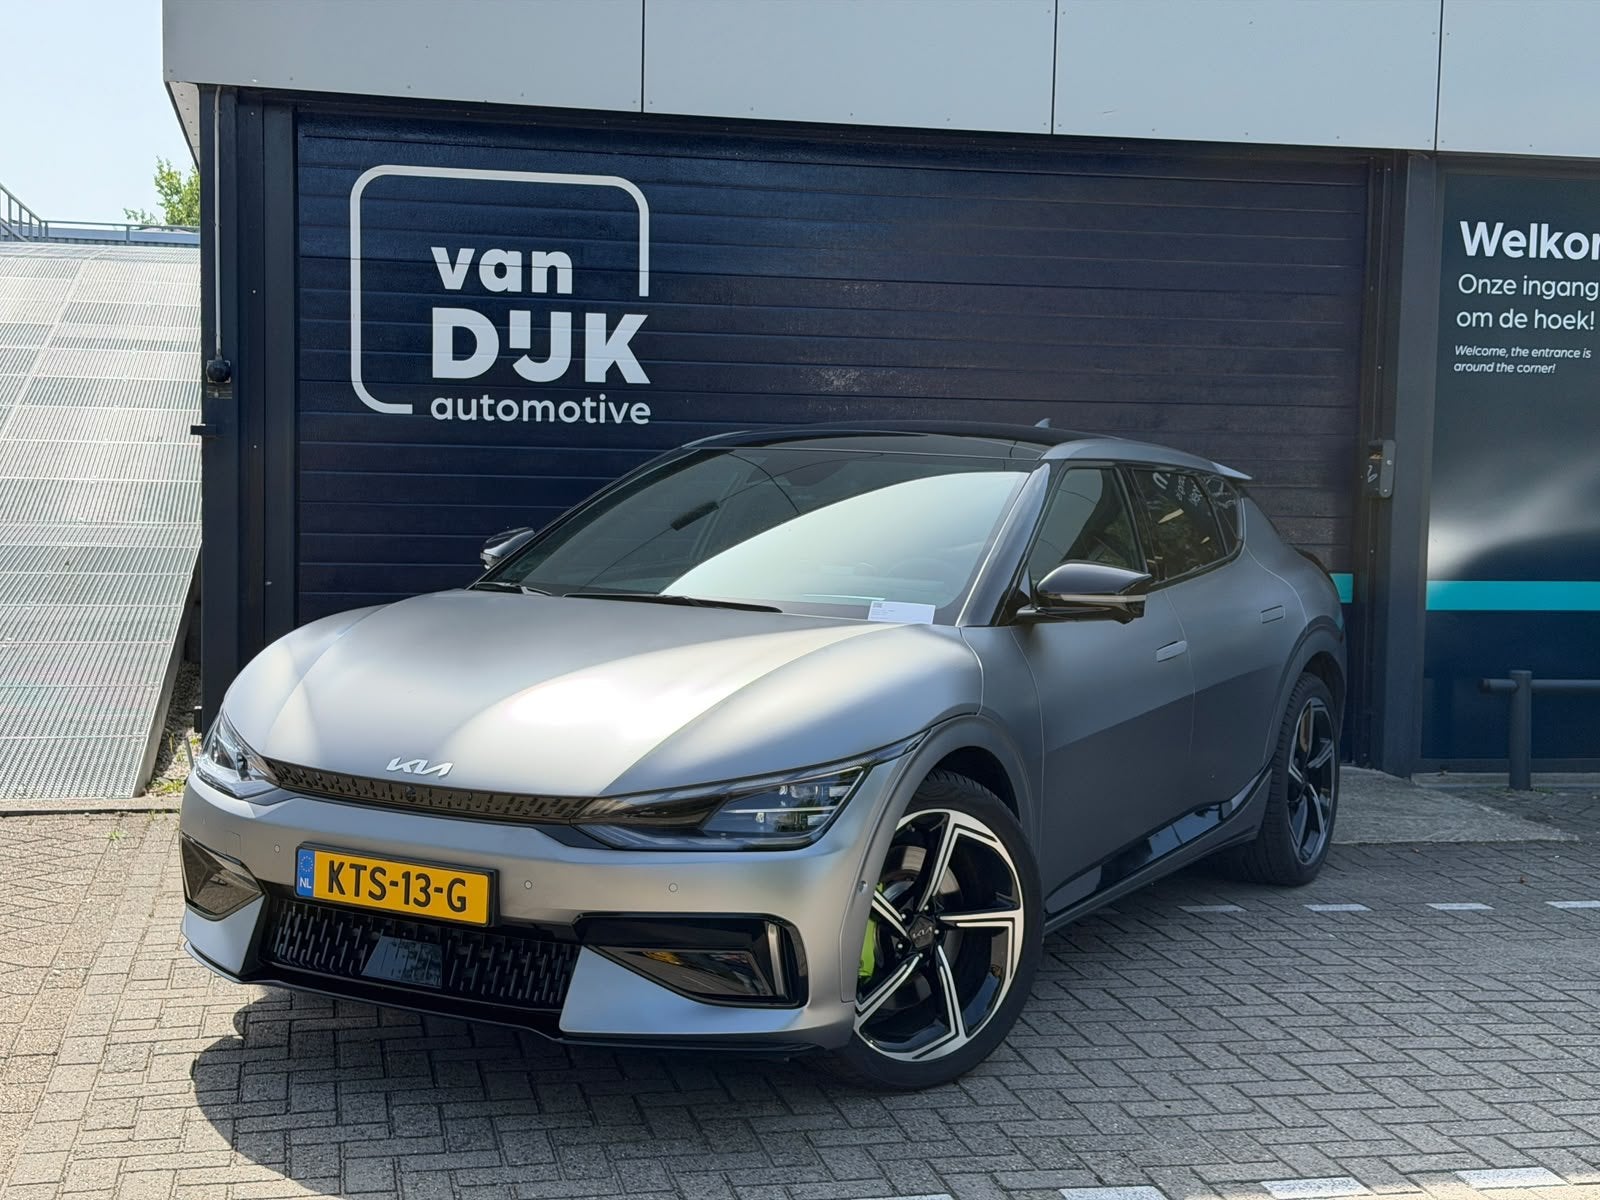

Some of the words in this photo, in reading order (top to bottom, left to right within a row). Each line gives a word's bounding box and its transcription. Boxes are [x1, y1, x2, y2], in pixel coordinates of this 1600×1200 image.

[1460, 221, 1600, 260] Welko
[431, 247, 573, 294] van
[1458, 273, 1517, 295] Onze
[1522, 275, 1599, 301] ingang
[1456, 311, 1493, 328] om
[1499, 308, 1528, 329] de
[1534, 309, 1595, 331] hoek!
[1455, 345, 1509, 358] Welcome,
[1510, 347, 1530, 357] the
[1531, 348, 1580, 359] entrance
[1582, 348, 1592, 359] is
[1453, 362, 1494, 373] around
[1496, 363, 1515, 373] the
[1516, 363, 1556, 374] corner!
[430, 394, 651, 425] automotive
[300, 876, 312, 889] NL
[328, 859, 467, 914] KTS-13-G
